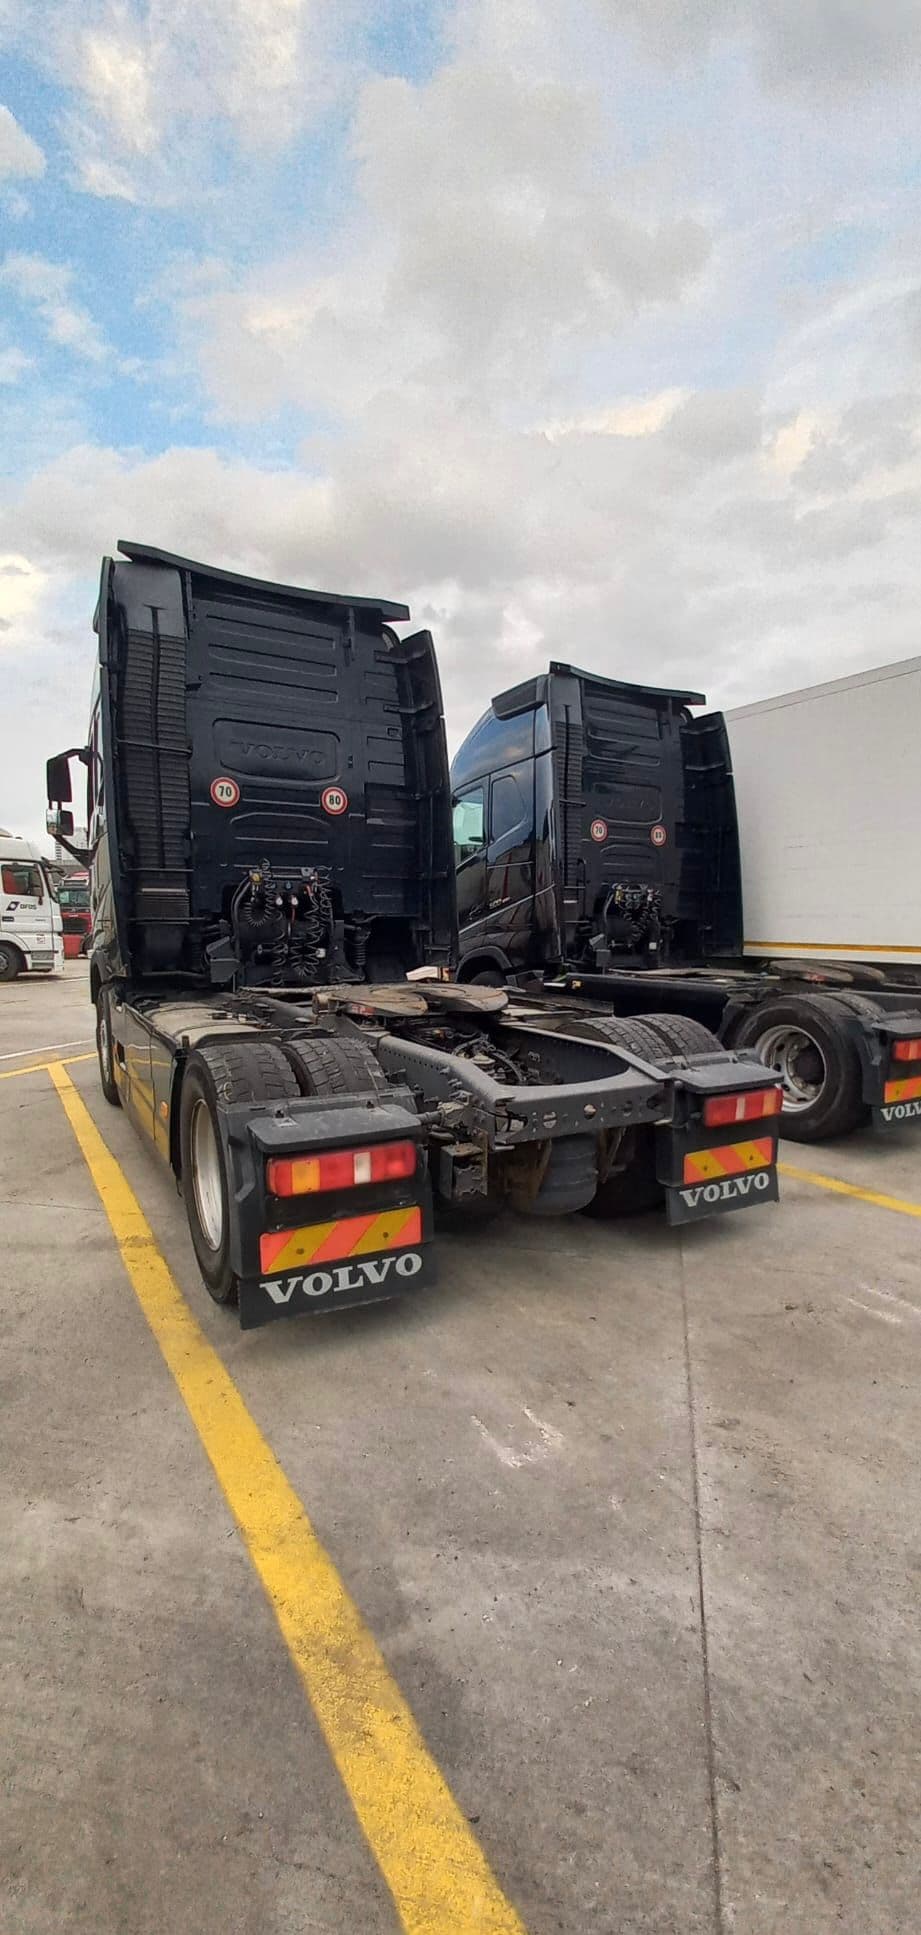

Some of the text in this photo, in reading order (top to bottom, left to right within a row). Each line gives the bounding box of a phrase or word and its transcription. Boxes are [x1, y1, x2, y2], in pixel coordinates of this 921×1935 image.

[219, 786, 232, 797] 70
[329, 795, 341, 805] 80
[679, 1172, 770, 1207] VOLVO
[259, 1252, 423, 1304] VOLVO
